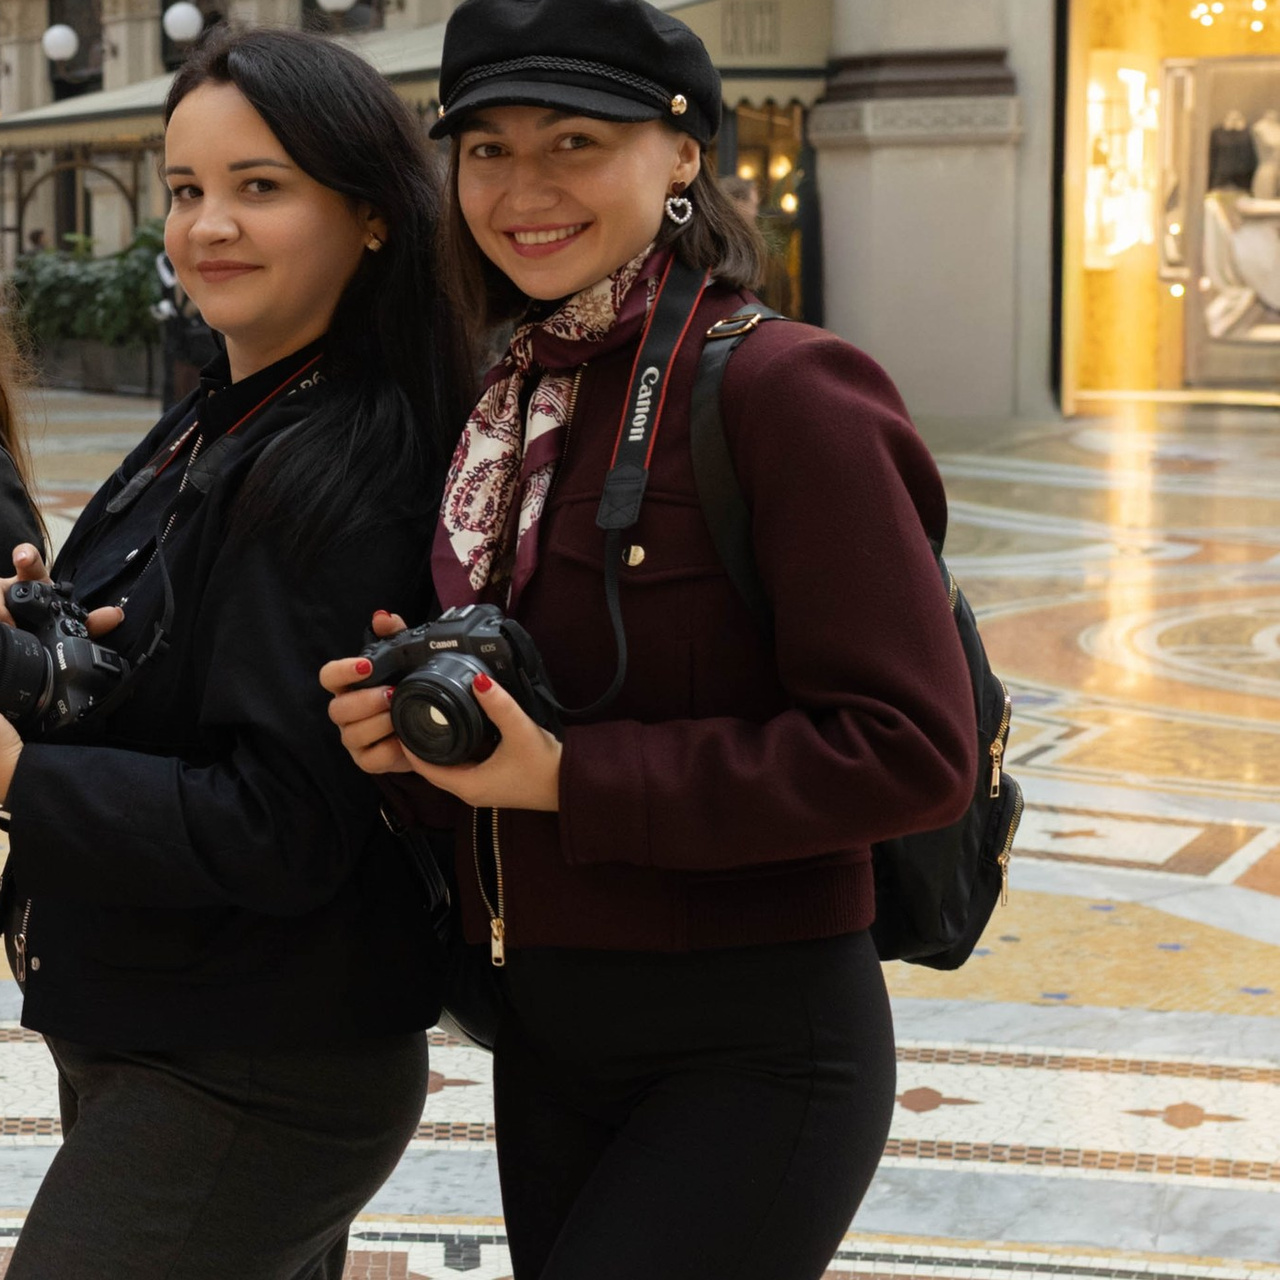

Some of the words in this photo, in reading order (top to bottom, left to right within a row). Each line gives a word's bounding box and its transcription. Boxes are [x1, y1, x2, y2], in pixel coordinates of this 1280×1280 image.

[628, 366, 659, 442] Canon
[428, 639, 459, 650] Canon
[480, 643, 496, 653] EOS
[56, 642, 67, 671] Canon
